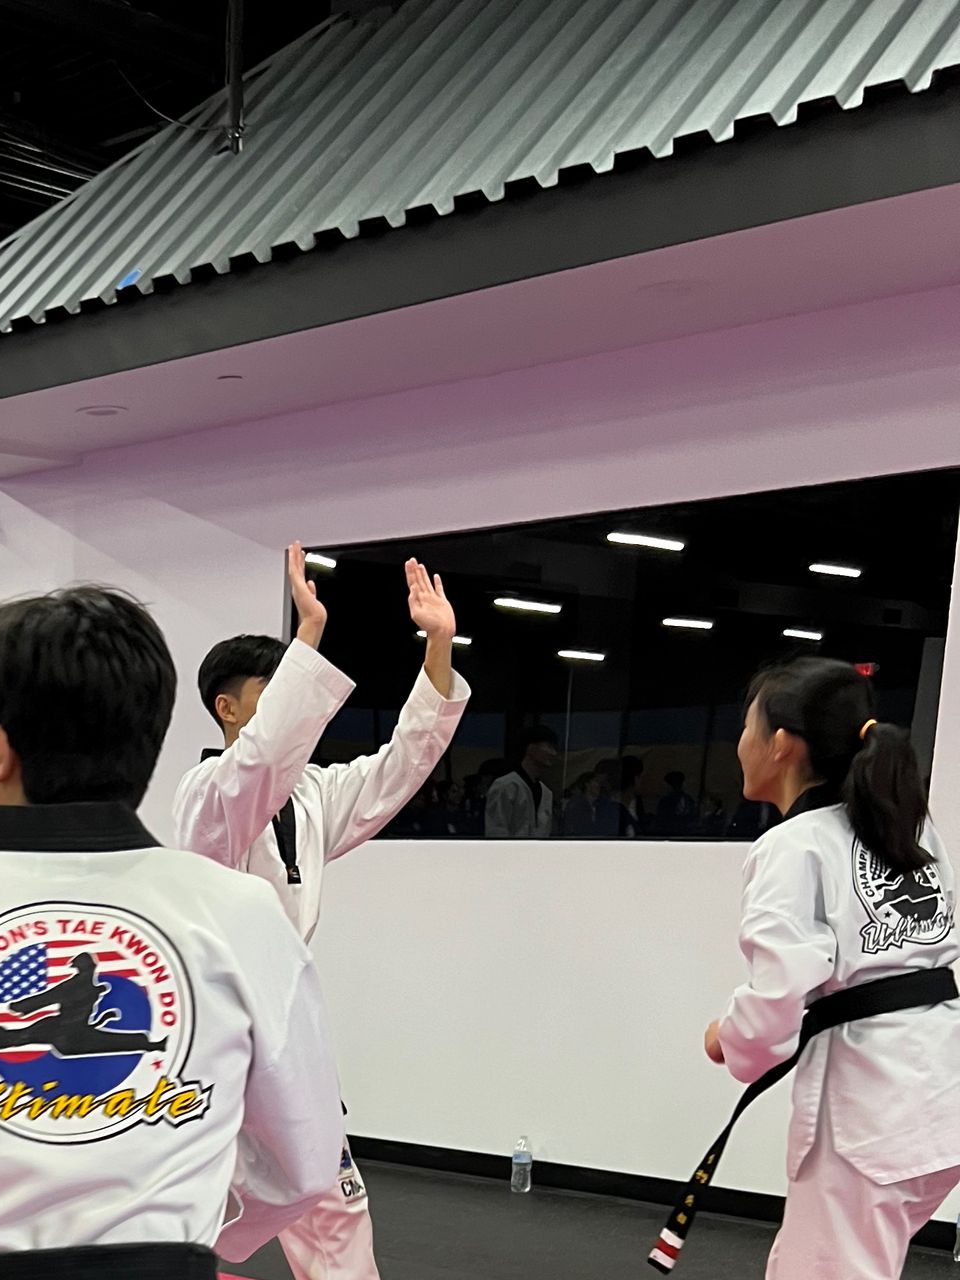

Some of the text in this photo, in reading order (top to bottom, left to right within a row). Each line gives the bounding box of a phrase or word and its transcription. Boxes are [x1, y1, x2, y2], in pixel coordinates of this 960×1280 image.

[858, 846, 876, 898] CHAMPI
[864, 906, 955, 951] Ultima
[56, 918, 106, 936] TAE
[109, 925, 172, 984] KWON
[158, 990, 178, 1028] DO
